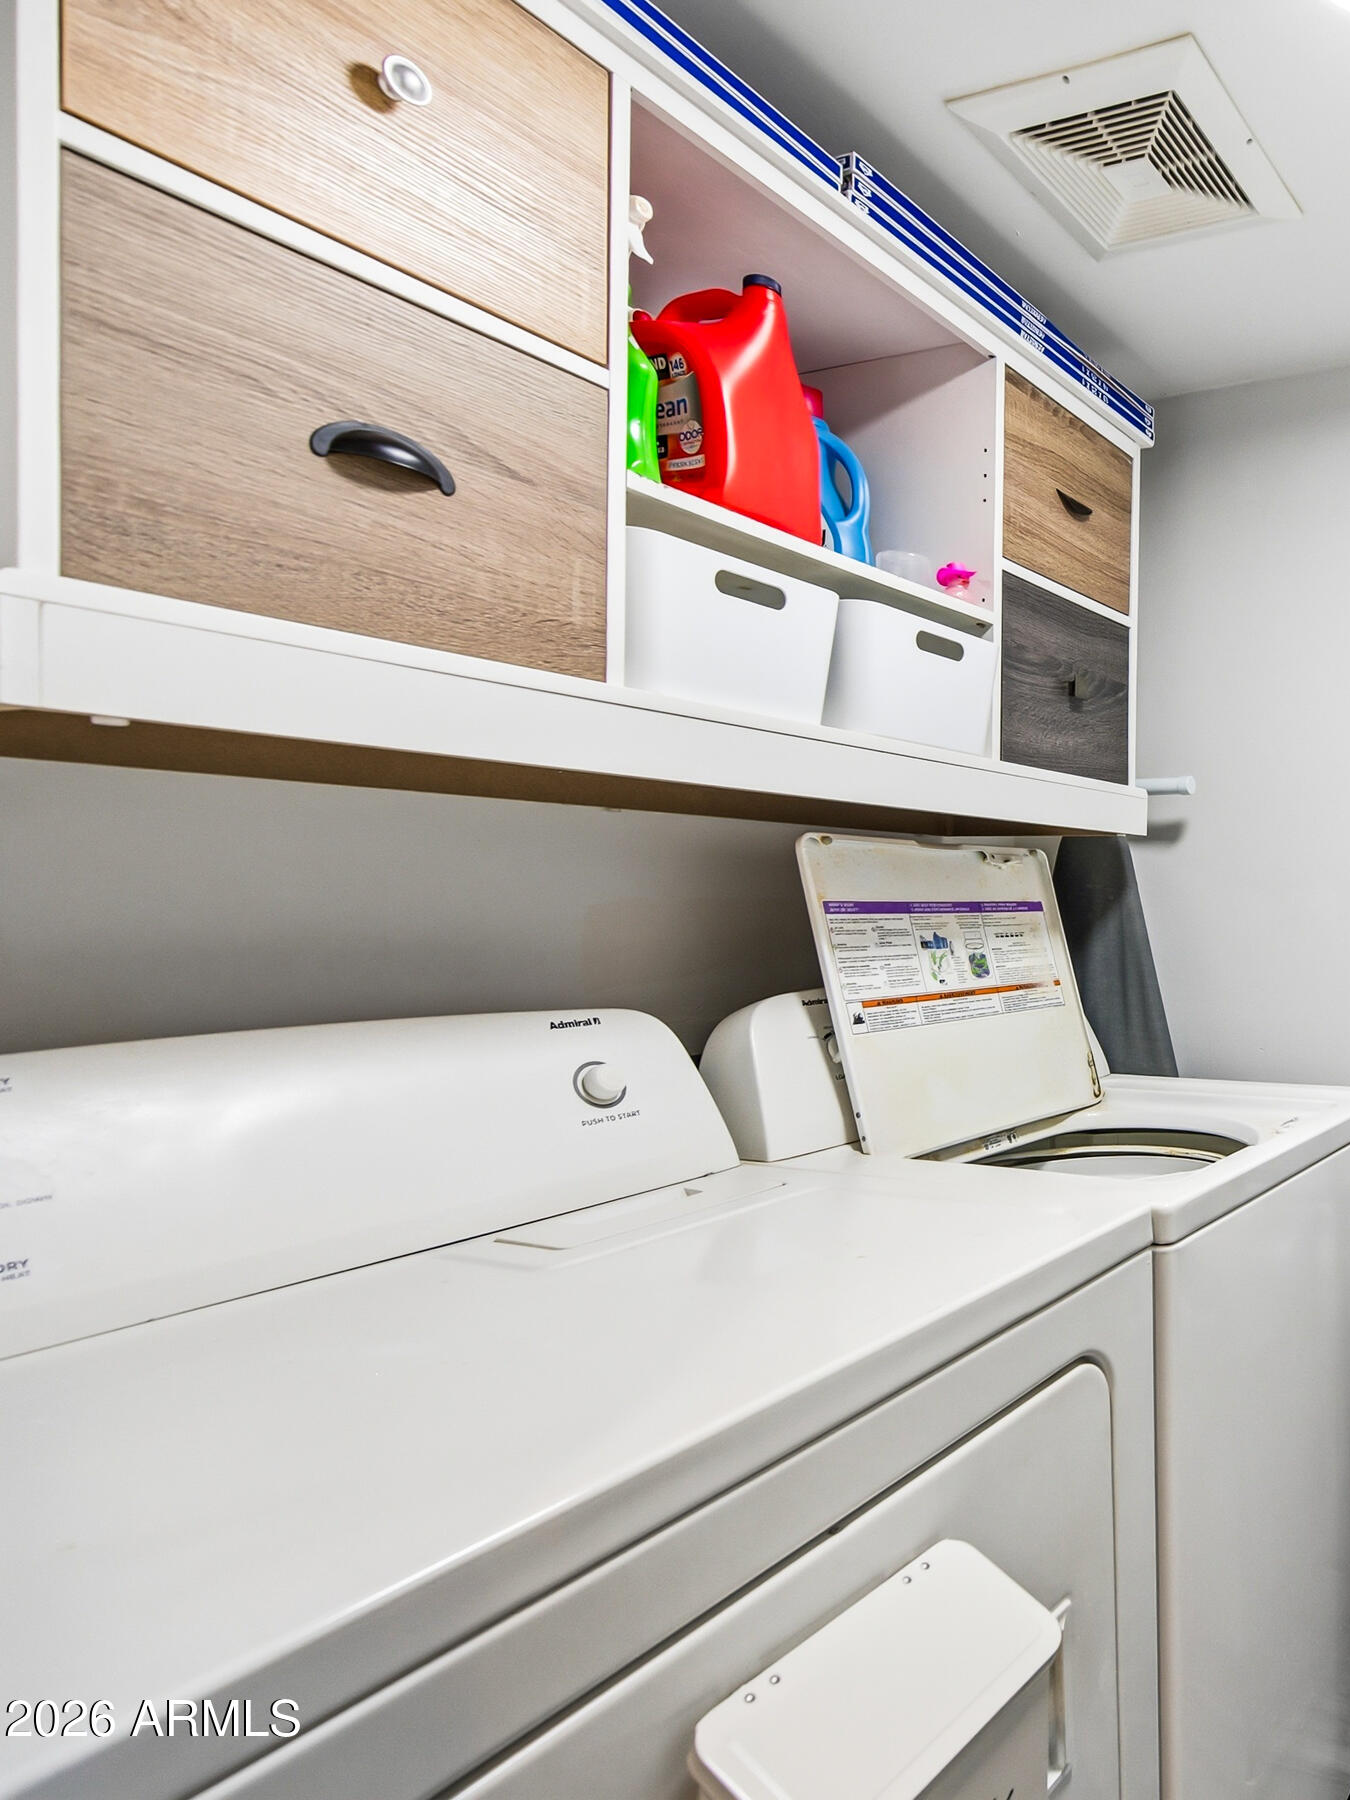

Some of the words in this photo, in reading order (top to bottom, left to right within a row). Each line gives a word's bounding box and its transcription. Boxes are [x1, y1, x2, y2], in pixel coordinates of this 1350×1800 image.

[670, 358, 685, 370] 146
[656, 397, 687, 419] ean
[549, 1017, 592, 1030] Admiral
[582, 1118, 604, 1127] PUSH
[606, 1114, 616, 1122] TO
[618, 1110, 641, 1120] START
